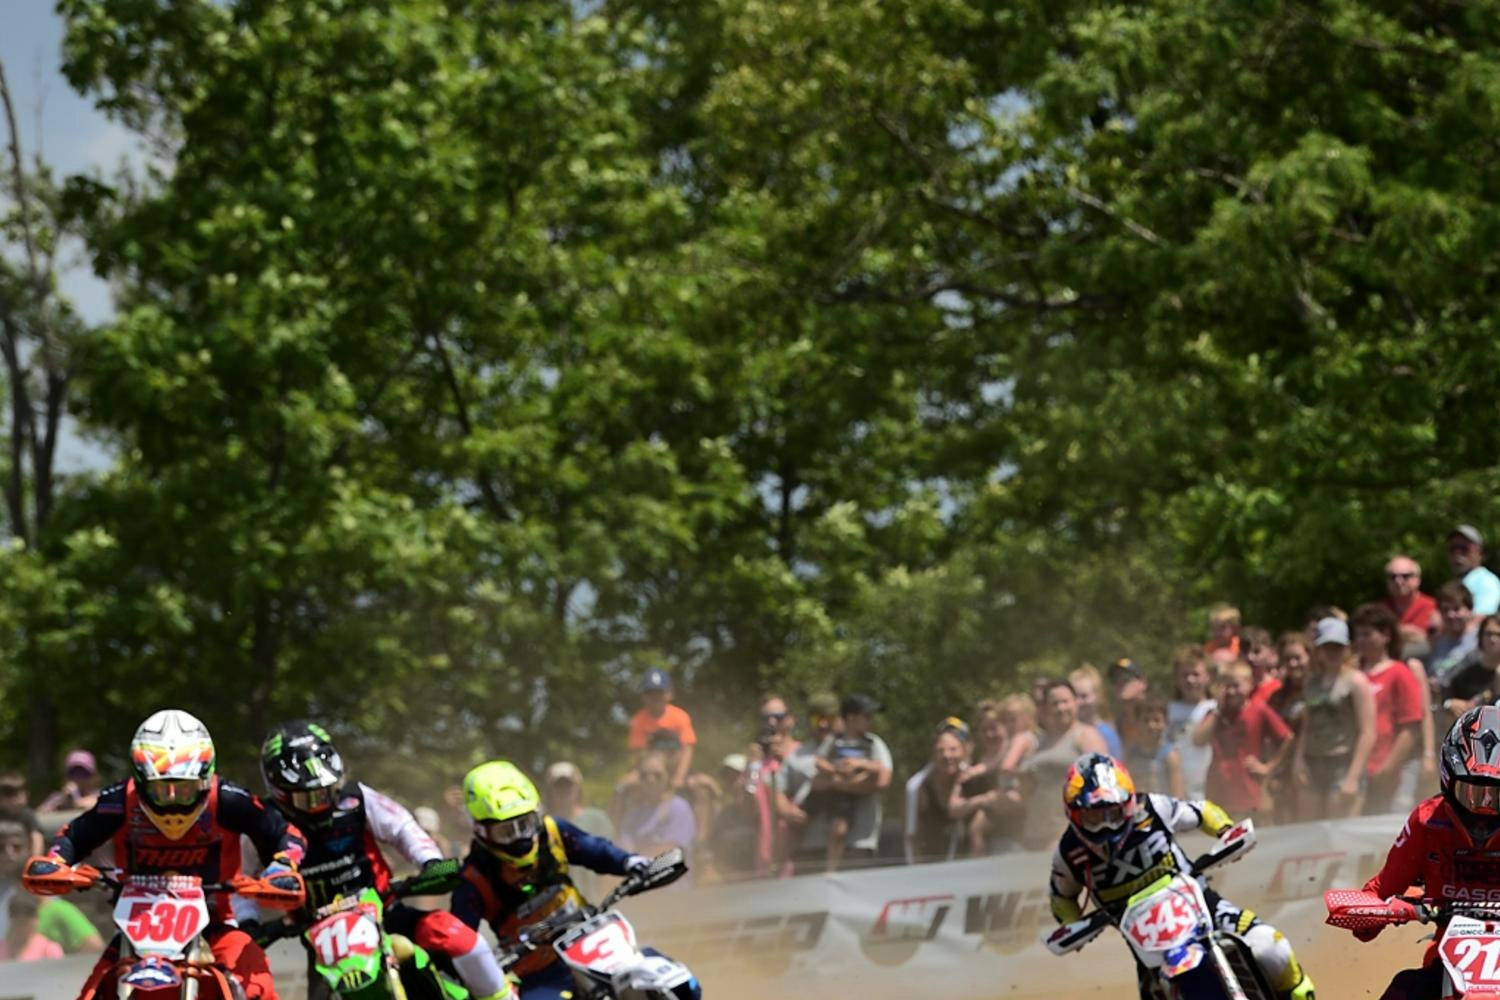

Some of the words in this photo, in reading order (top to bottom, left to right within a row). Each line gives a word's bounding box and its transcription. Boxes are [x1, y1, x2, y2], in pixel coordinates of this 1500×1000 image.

[137, 848, 208, 868] THOR
[1092, 830, 1170, 885] FXR
[126, 902, 200, 944] 530
[314, 915, 380, 967] 114
[581, 922, 628, 964] 3
